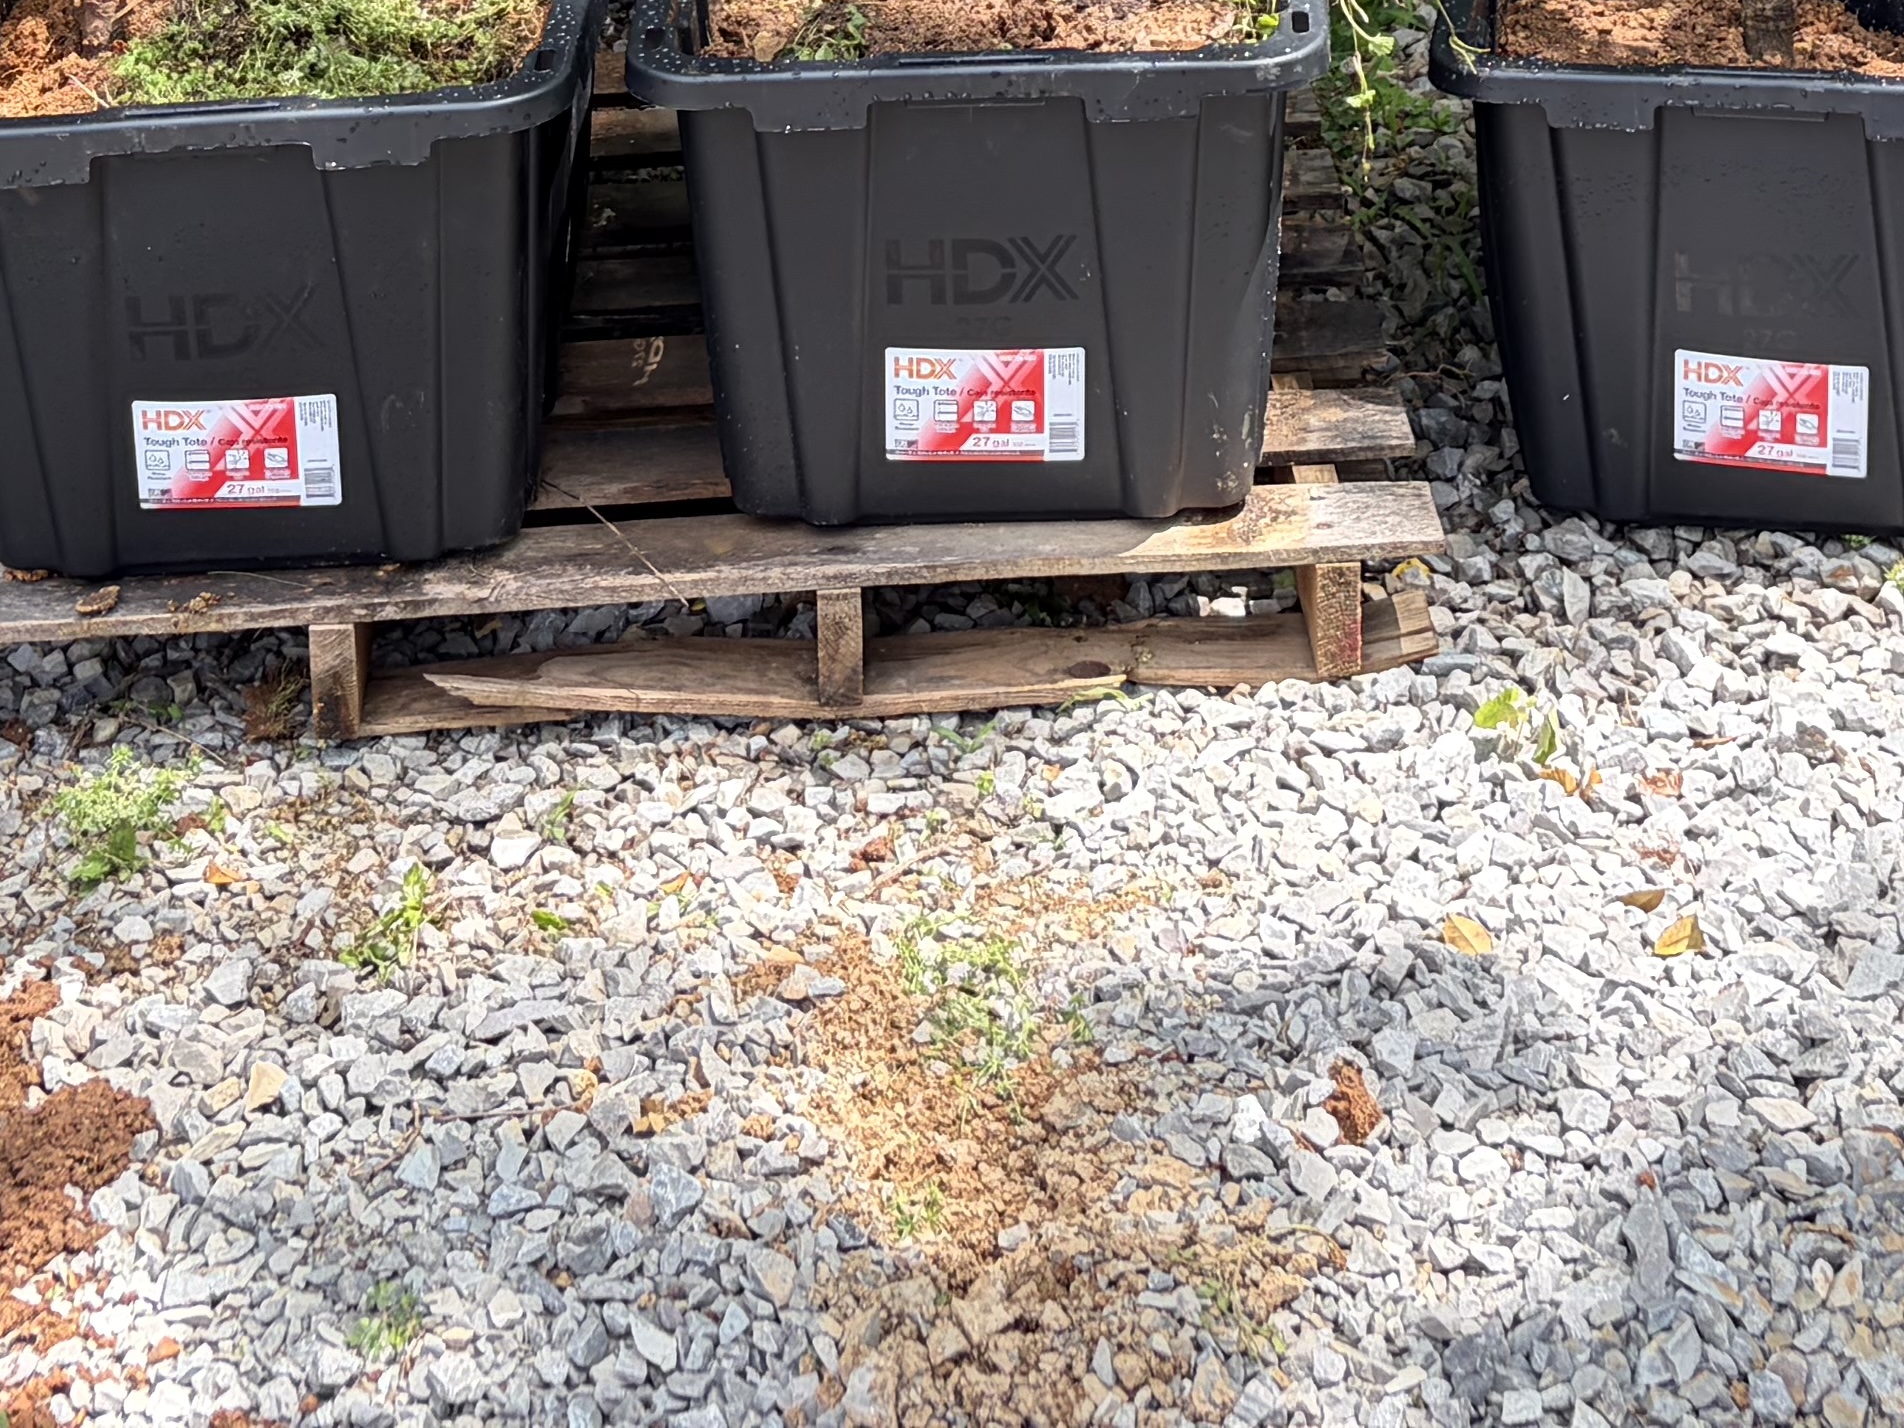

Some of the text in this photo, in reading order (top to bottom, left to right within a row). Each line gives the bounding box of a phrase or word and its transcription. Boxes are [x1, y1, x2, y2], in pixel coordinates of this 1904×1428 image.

[885, 234, 1080, 305] HDX
[1674, 251, 1861, 318] HDX
[125, 283, 327, 361] HDX
[894, 356, 957, 380] HDX
[1683, 359, 1744, 387] HDX
[894, 385, 930, 397] Tough
[932, 386, 957, 396] Tote
[1683, 387, 1717, 402] Tough
[1719, 391, 1744, 404] Tote
[141, 409, 206, 432] HDX
[144, 436, 180, 447] Tough
[182, 437, 207, 447] Tote
[972, 436, 991, 448] 27
[992, 438, 1010, 448] gal
[1757, 444, 1775, 456] 27
[1776, 448, 1794, 458] gal
[226, 483, 245, 494] 27
[247, 485, 265, 495] gal
